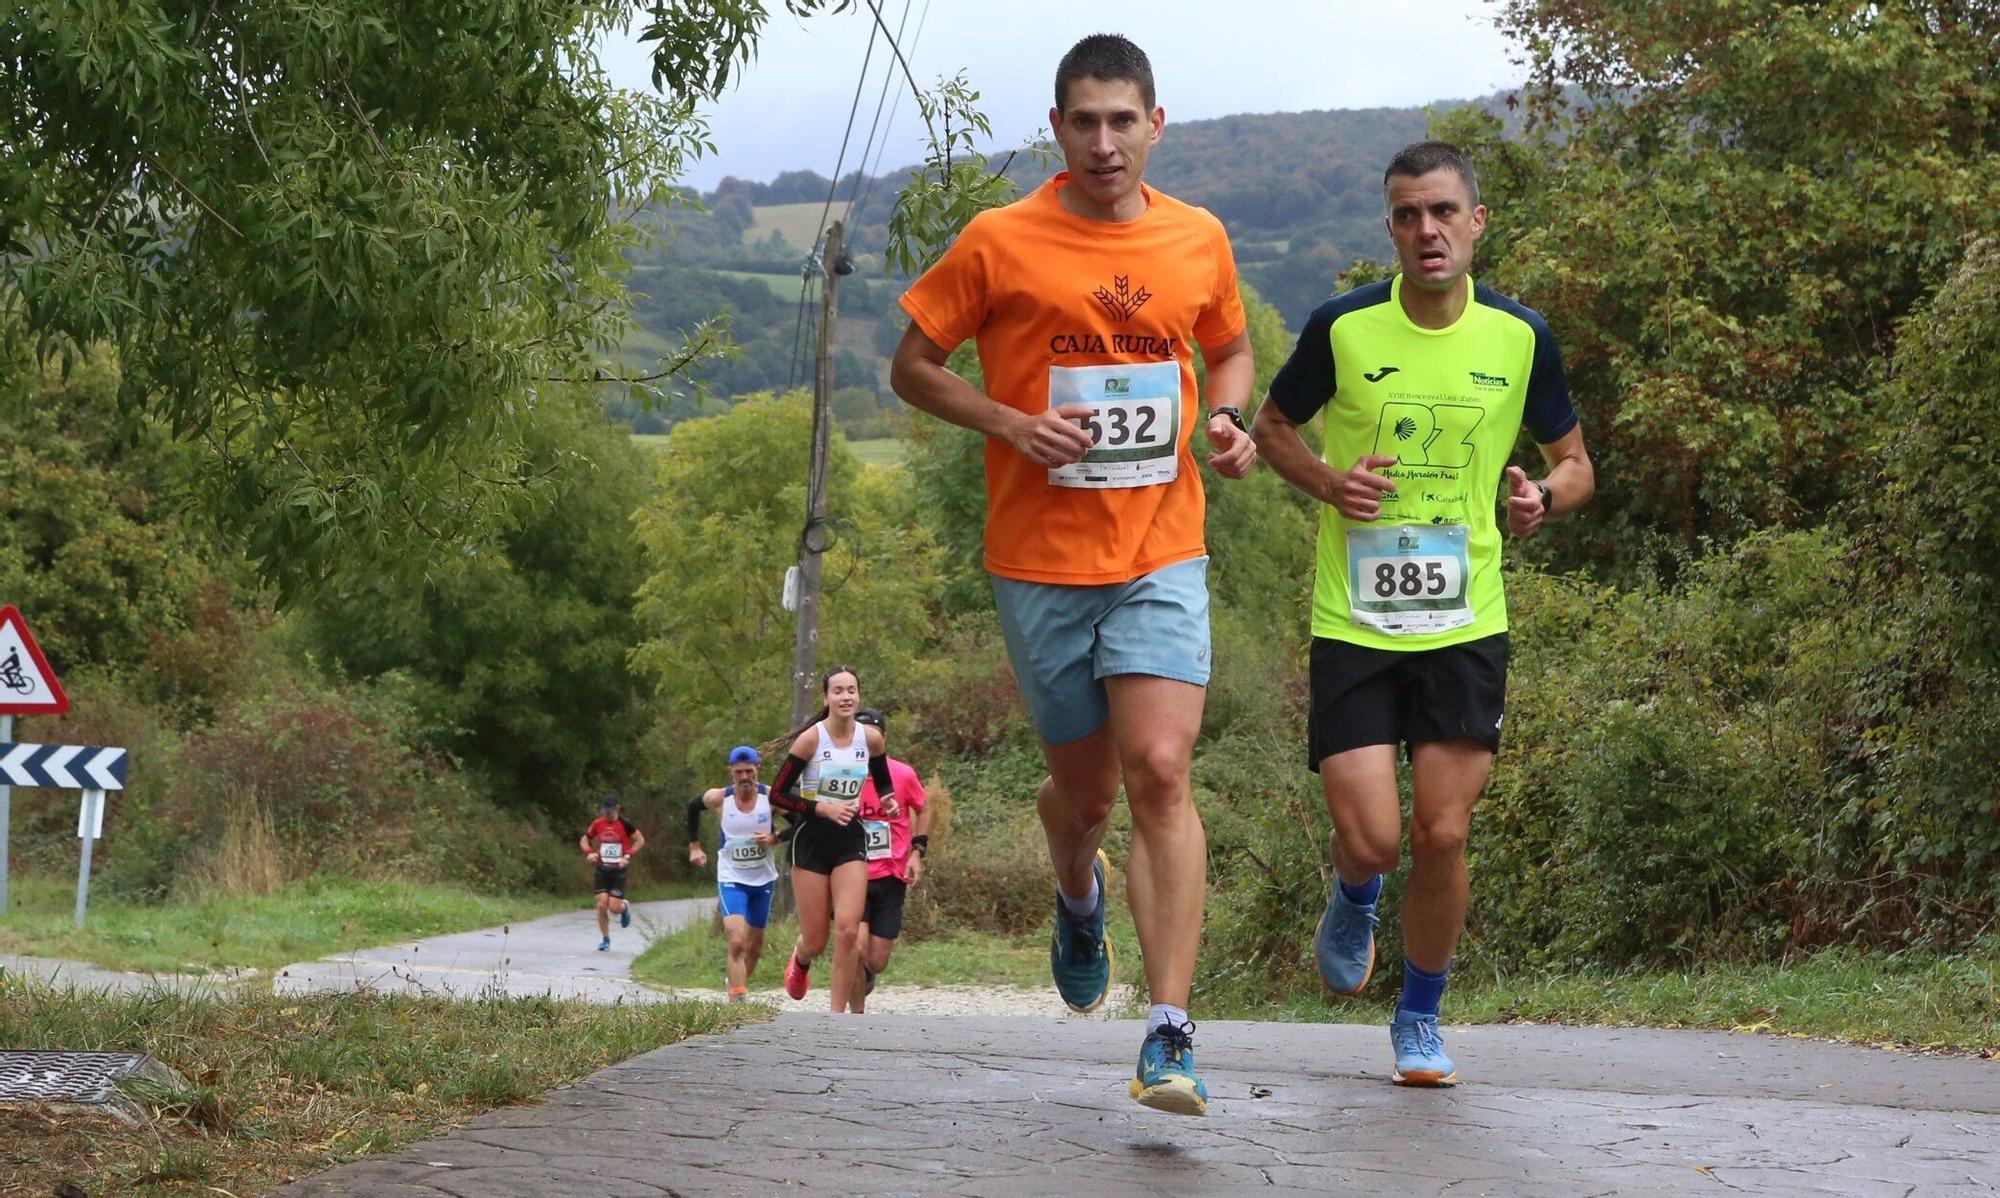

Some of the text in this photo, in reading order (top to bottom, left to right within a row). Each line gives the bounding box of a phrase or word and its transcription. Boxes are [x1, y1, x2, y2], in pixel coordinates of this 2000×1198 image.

[1051, 334, 1108, 354] CAJA
[1079, 405, 1156, 445] 532
[1383, 469, 1459, 480] Media Maratón Trail
[1374, 562, 1447, 597] 885
[828, 779, 858, 794] 810
[734, 846, 766, 858] 1050
